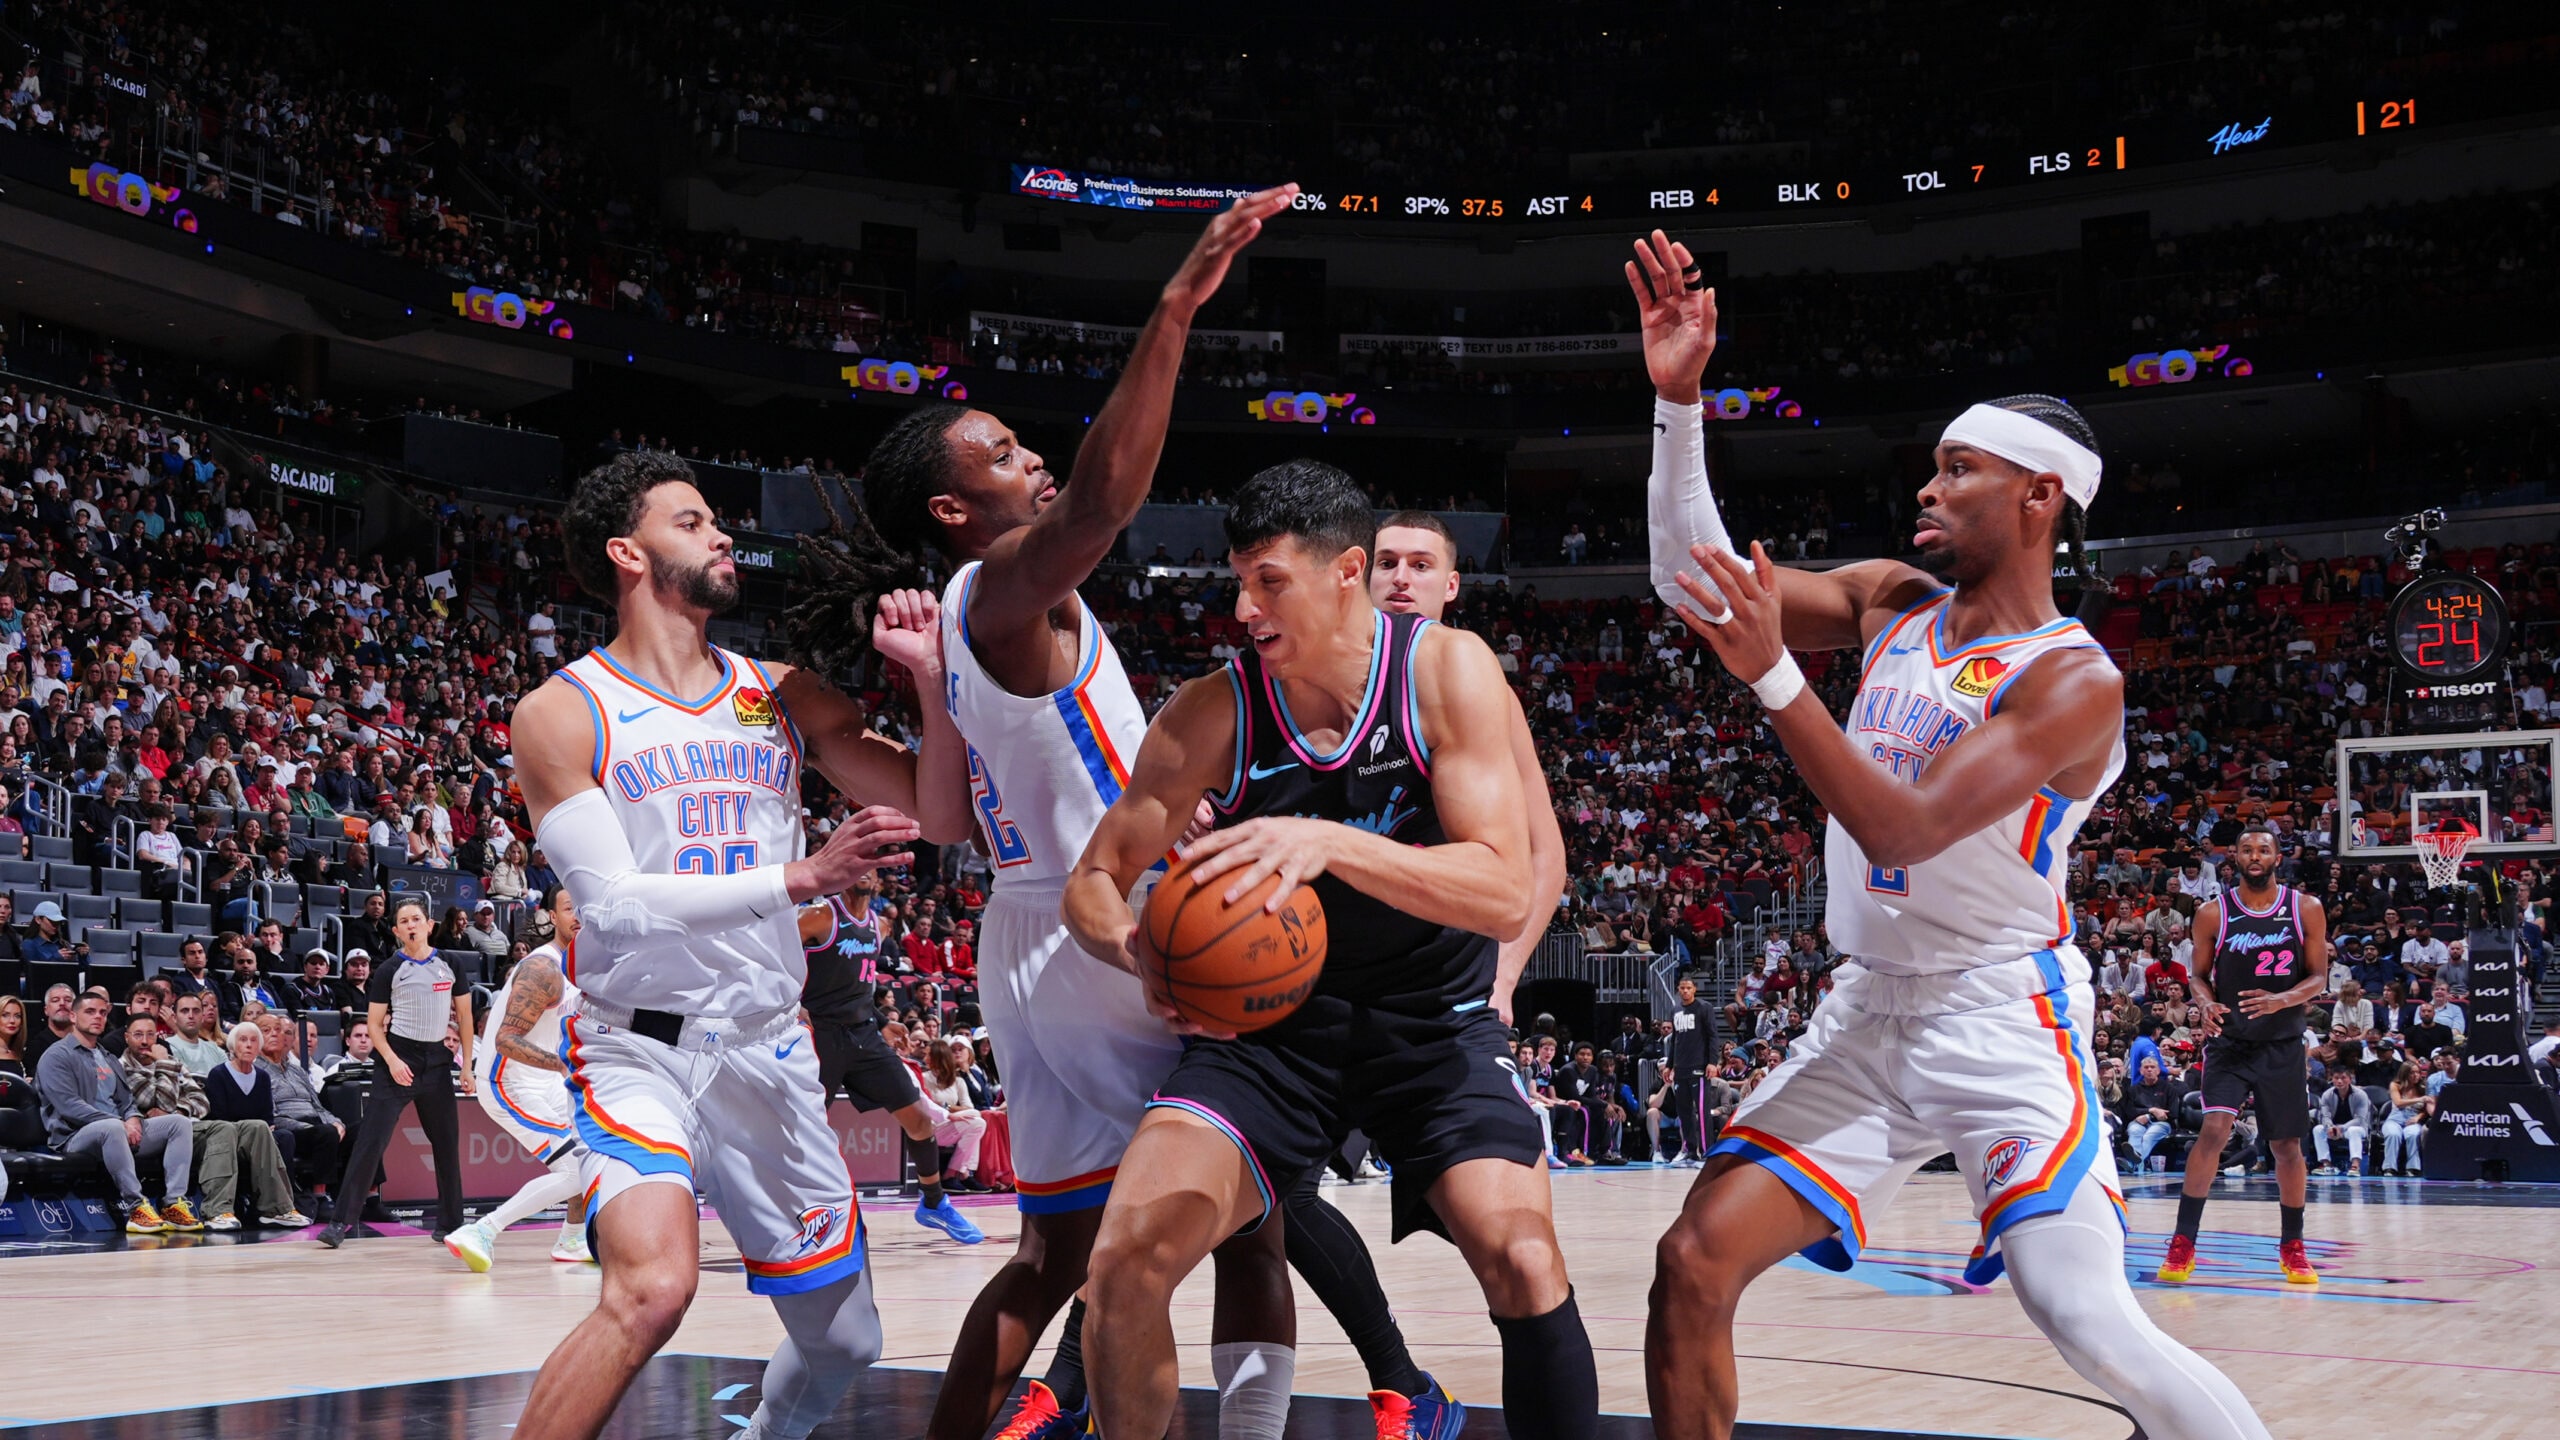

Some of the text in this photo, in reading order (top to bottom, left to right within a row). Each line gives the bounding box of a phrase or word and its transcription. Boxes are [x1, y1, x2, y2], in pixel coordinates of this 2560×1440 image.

[2207, 98, 2416, 155] Heat 21
[2029, 149, 2101, 175] FLS 2
[86, 161, 151, 217] GO
[1020, 167, 1079, 193] Acordis
[1084, 178, 1130, 193] Preferred
[1131, 184, 1175, 197] Business
[1176, 187, 1224, 199] Solutions
[1778, 182, 1850, 202] BLK 0
[1902, 164, 1985, 193] TOL 7
[1125, 195, 1137, 205] of
[1137, 196, 1154, 206] the
[1155, 198, 1186, 208] Miami
[1291, 193, 1378, 212] G% 47.1
[1404, 197, 1503, 216] 3P% 37.5
[1526, 195, 1594, 215] AST 4
[1650, 189, 1719, 208] REB 4
[464, 285, 527, 330] GO
[978, 316, 1009, 330] NEED
[1463, 342, 1494, 354] TEXT
[858, 358, 920, 395] GO
[2126, 348, 2198, 386] GO
[1264, 391, 1327, 425] GO
[270, 462, 335, 496] BACARDÍ
[2425, 593, 2484, 620] 4:24
[2415, 620, 2482, 667] 24
[2429, 681, 2497, 699] TISSOT
[612, 739, 794, 803] OKLAHOMA
[1357, 755, 1411, 777] Robinhood
[677, 791, 752, 838] CITY
[2225, 926, 2294, 956] Miami
[2254, 949, 2295, 977] 22
[2439, 1109, 2511, 1125] American
[2453, 1123, 2511, 1138] Airlines
[1985, 1143, 2018, 1187] OKC
[801, 1210, 830, 1246] OKC
